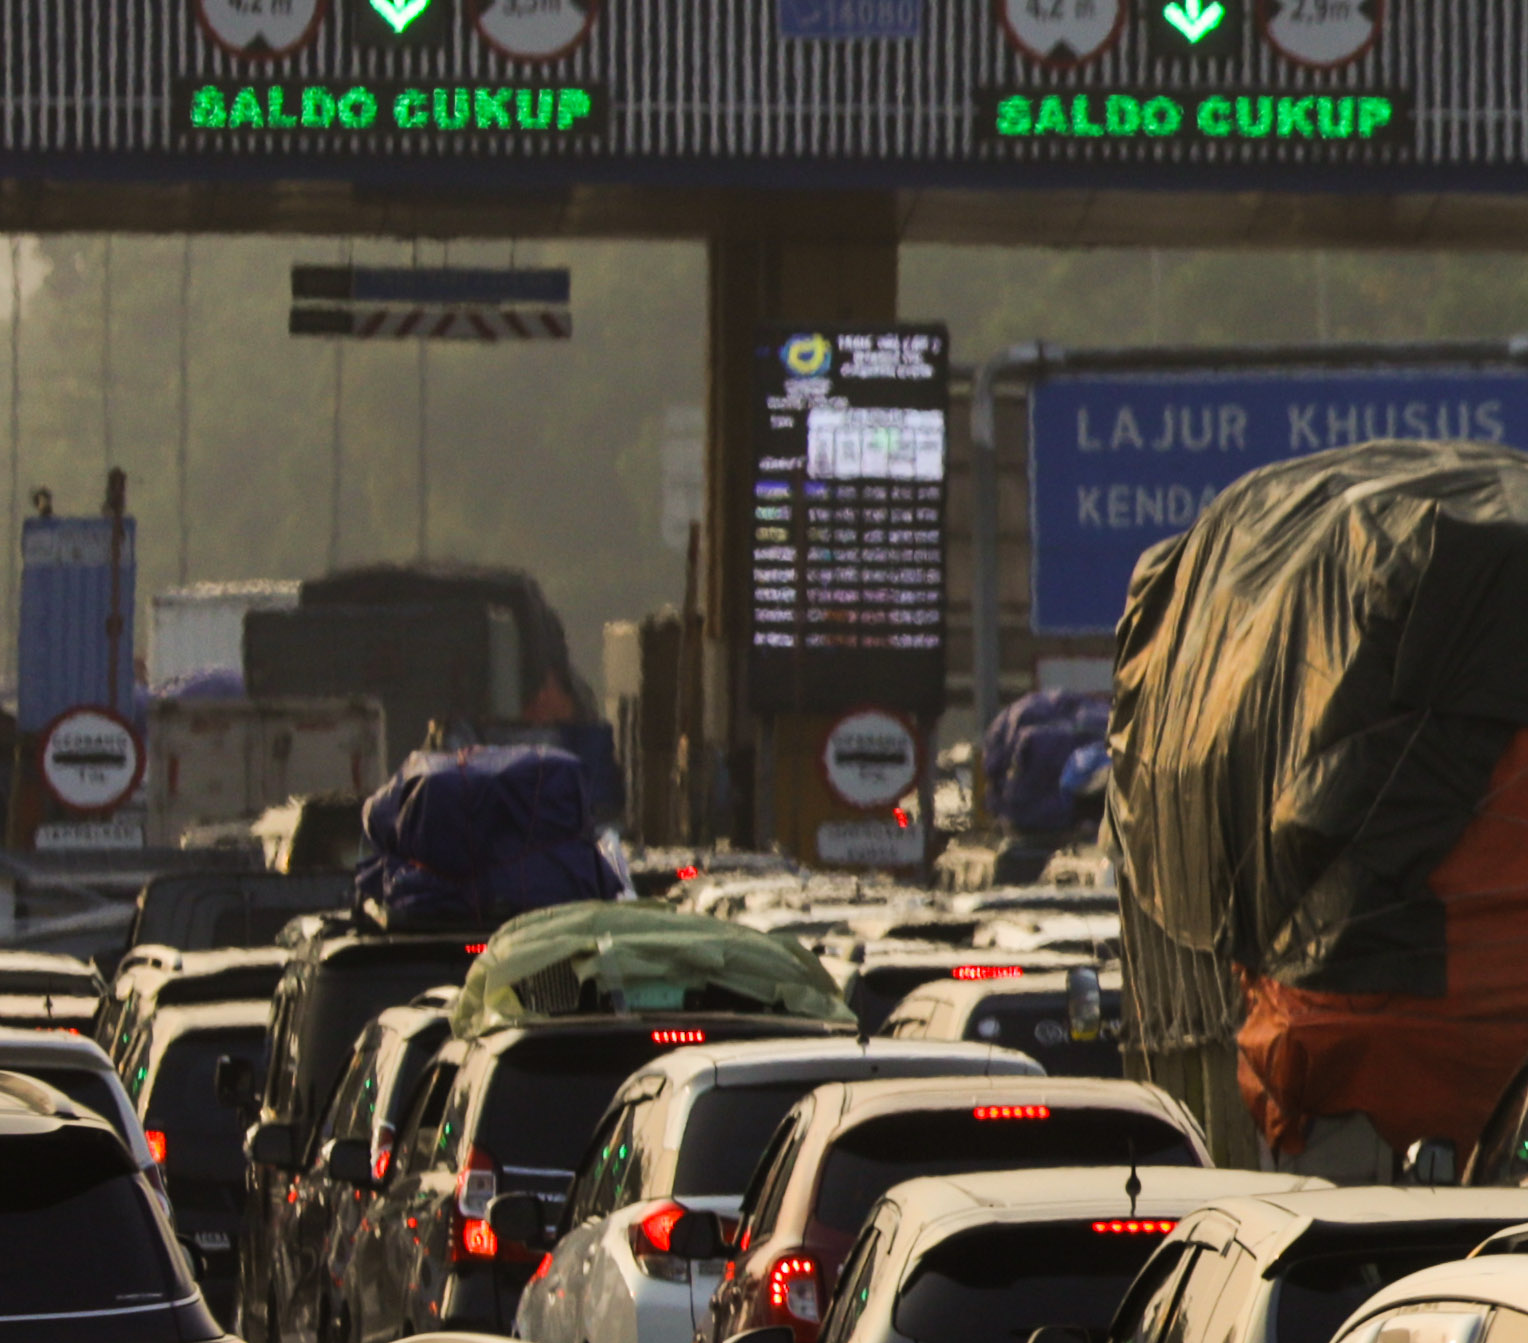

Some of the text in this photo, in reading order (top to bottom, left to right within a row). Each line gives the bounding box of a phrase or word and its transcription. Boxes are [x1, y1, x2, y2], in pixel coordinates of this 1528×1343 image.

[191, 85, 591, 130] SALDO CUKUP
[996, 94, 1392, 138] SALDO CUKUP
[1076, 400, 1506, 452] LAJUR KHUSUS
